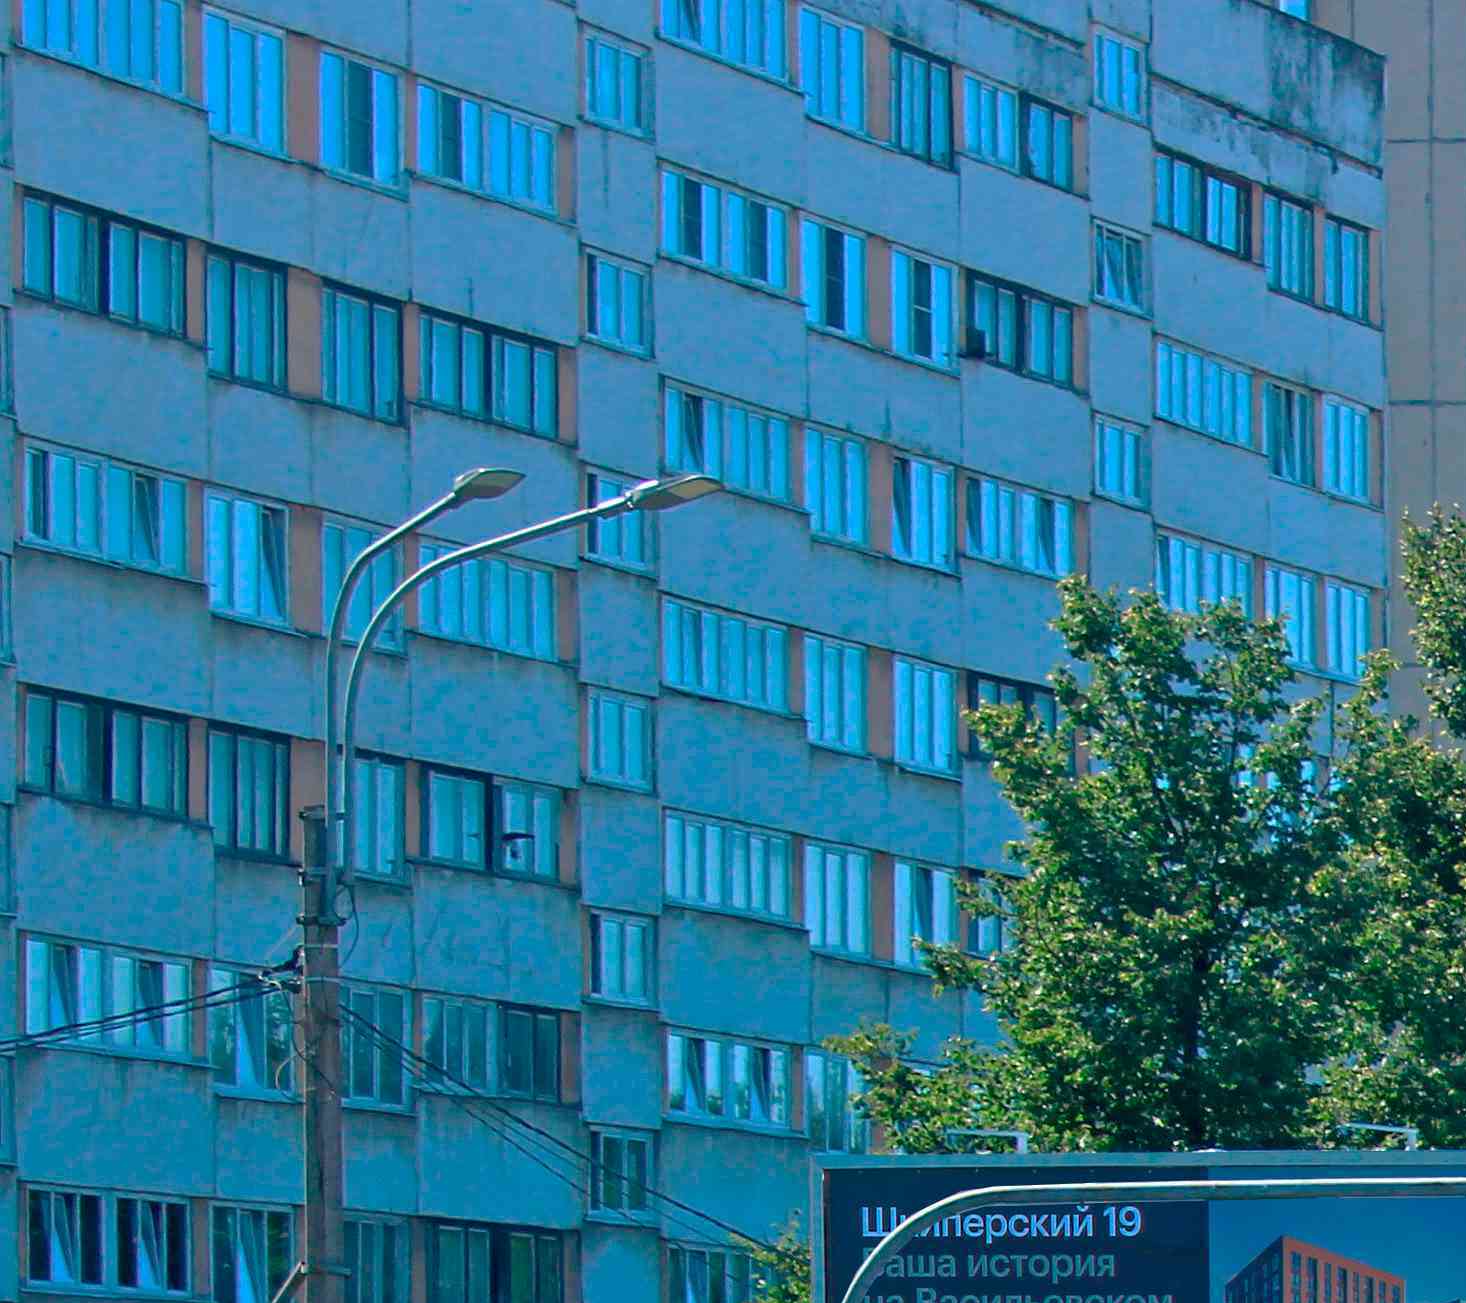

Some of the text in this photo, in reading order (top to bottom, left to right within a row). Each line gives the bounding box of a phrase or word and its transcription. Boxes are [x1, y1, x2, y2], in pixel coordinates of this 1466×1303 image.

[861, 1205, 1142, 1244] Шперский 19
[967, 1253, 1116, 1285] история
